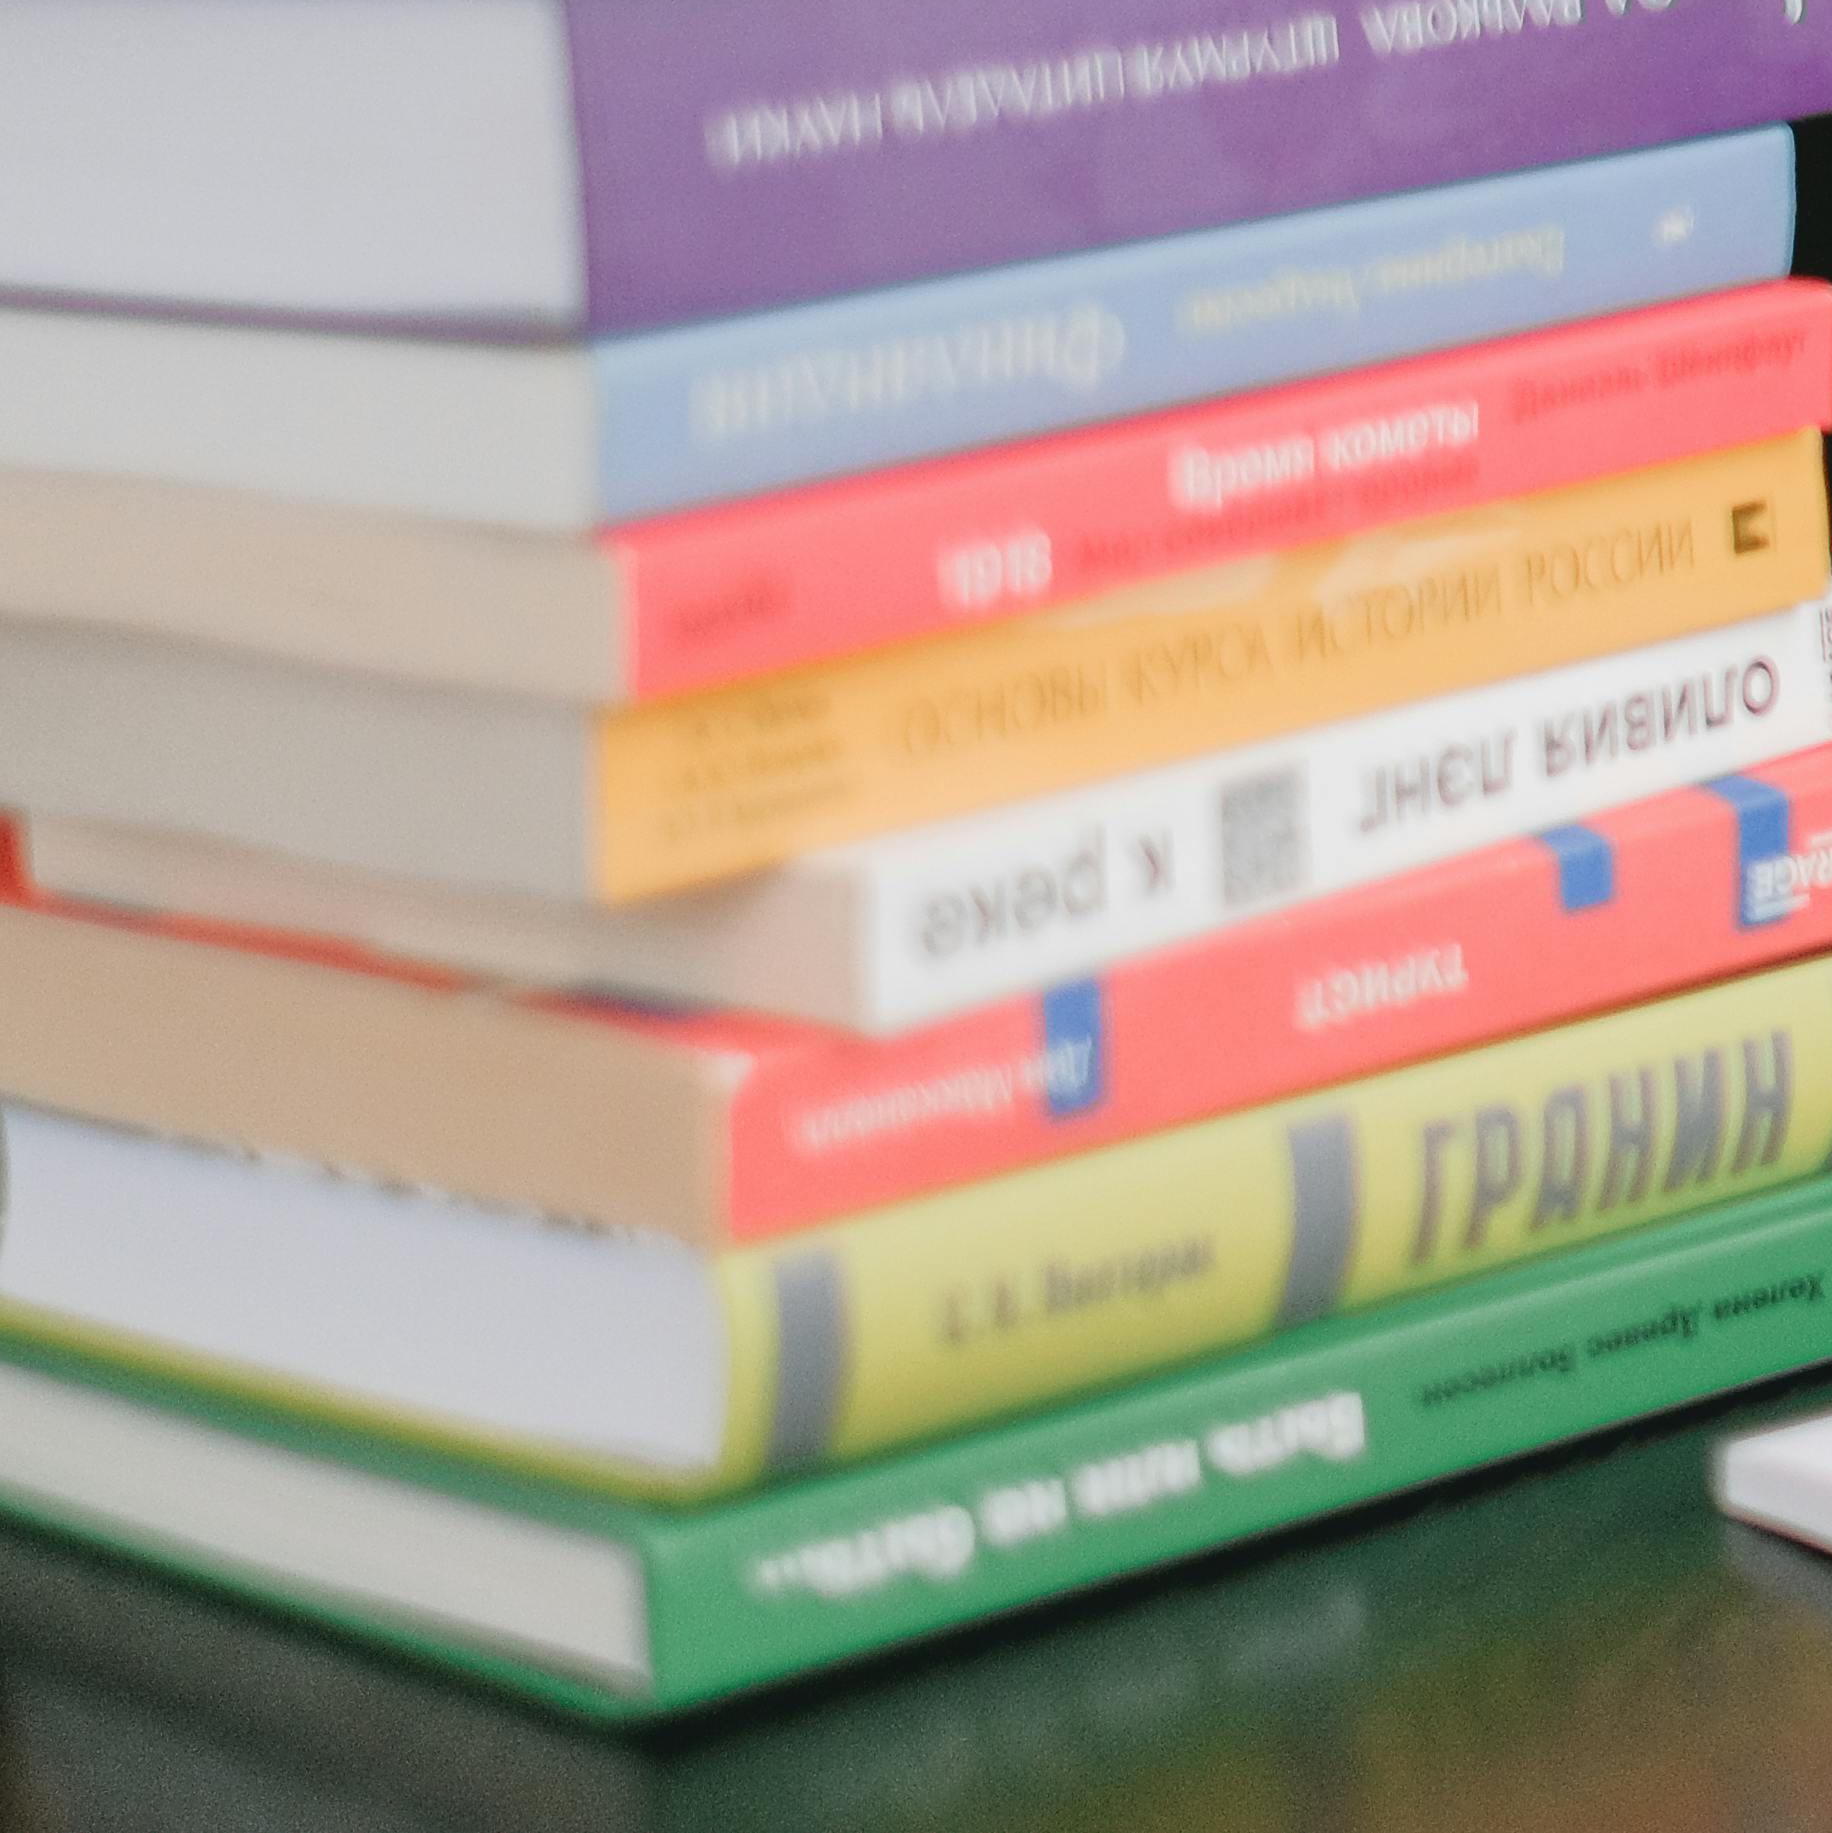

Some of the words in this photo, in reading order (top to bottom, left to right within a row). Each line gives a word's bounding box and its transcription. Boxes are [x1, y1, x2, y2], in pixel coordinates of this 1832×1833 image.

[890, 48, 1126, 134] ЦИТАДЕЛЬ
[1125, 11, 1340, 97] ШТУРМУЯ
[706, 92, 885, 169] НАУКИ
[1170, 439, 1315, 514] Время
[1323, 398, 1479, 470] кометы
[902, 664, 1110, 755] ОСНОВЫ
[1127, 620, 1271, 707] КУРСА
[1298, 573, 1502, 661] ИСТОРИИ
[1527, 518, 1696, 608] РОССИИ
[1543, 655, 1781, 777] ОЛИВИЯ
[1360, 729, 1518, 835] ЛЭНГ
[920, 825, 1108, 959] реке
[1297, 944, 1468, 1028] ТУРИСТ
[1410, 1030, 1793, 1262] ГРАНИН
[1586, 1304, 1696, 1361] Древес
[1712, 1273, 1827, 1321] Хелена
[1207, 1391, 1366, 1477] Быть
[1068, 1439, 1200, 1518] или
